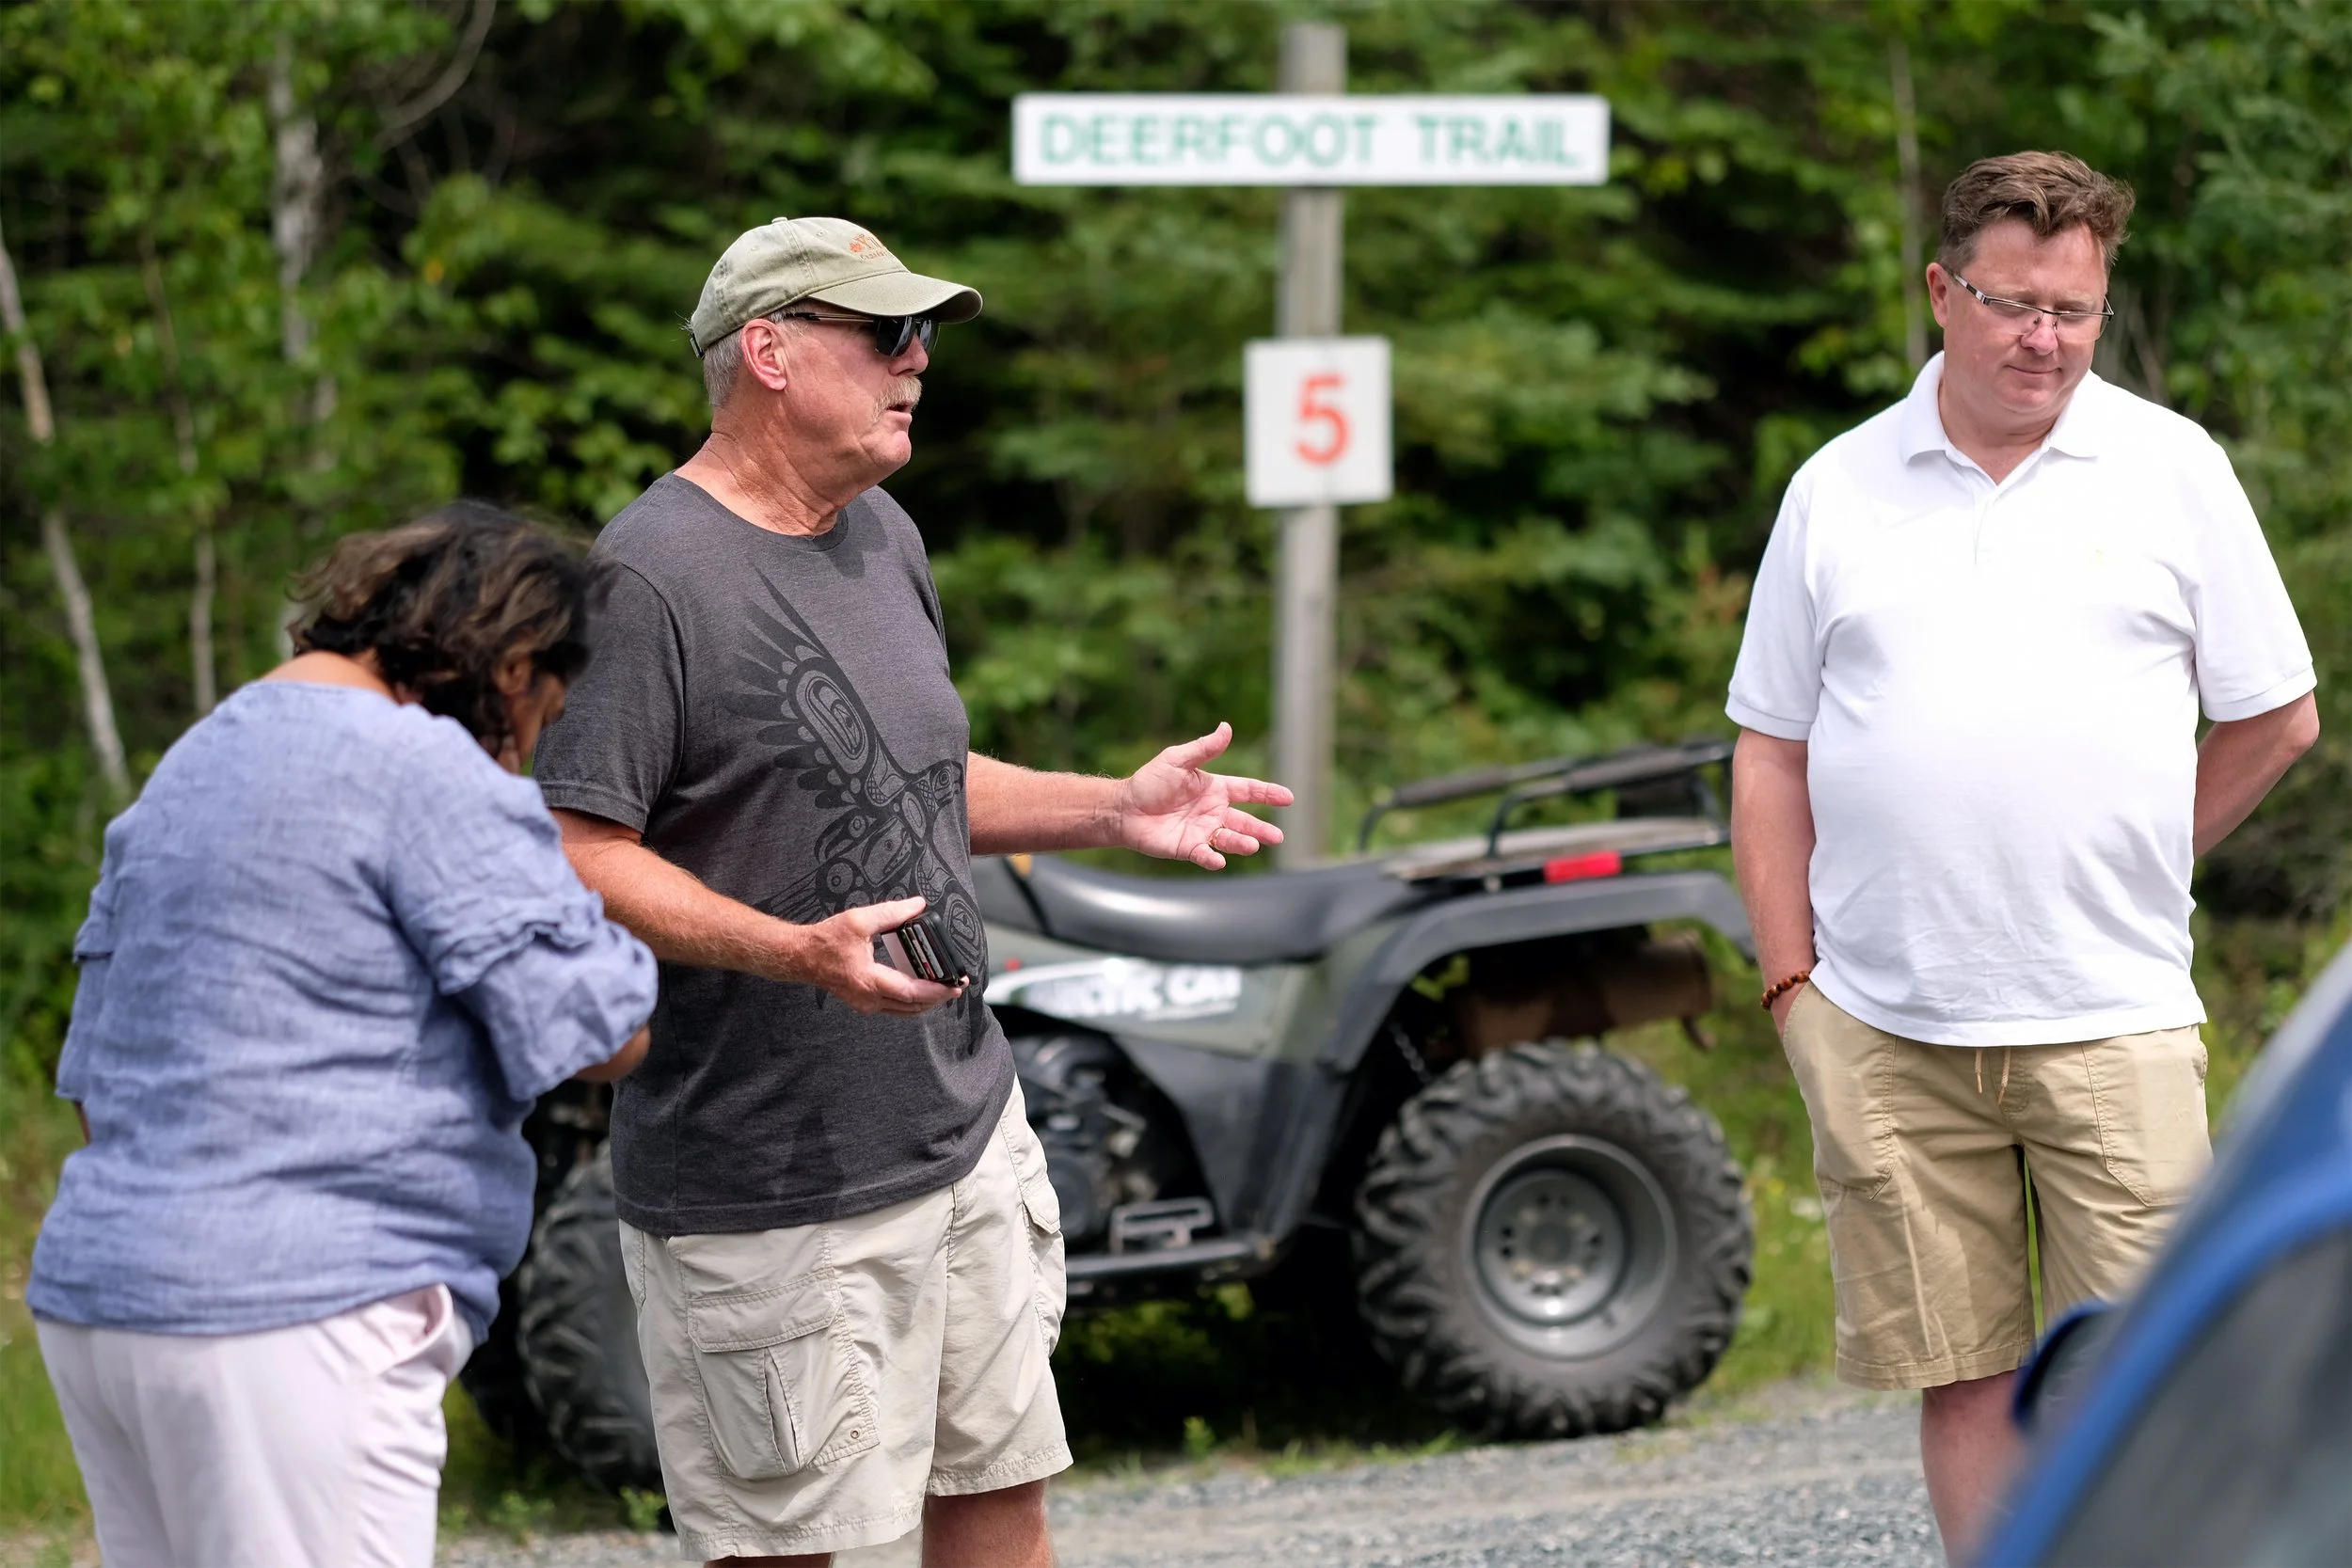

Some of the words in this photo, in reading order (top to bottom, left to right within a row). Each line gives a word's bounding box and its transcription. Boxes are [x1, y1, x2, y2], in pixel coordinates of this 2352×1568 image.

[1040, 112, 1379, 166] DEERFOOT
[1413, 114, 1583, 166] TRAIL
[1295, 372, 1351, 467] 5
